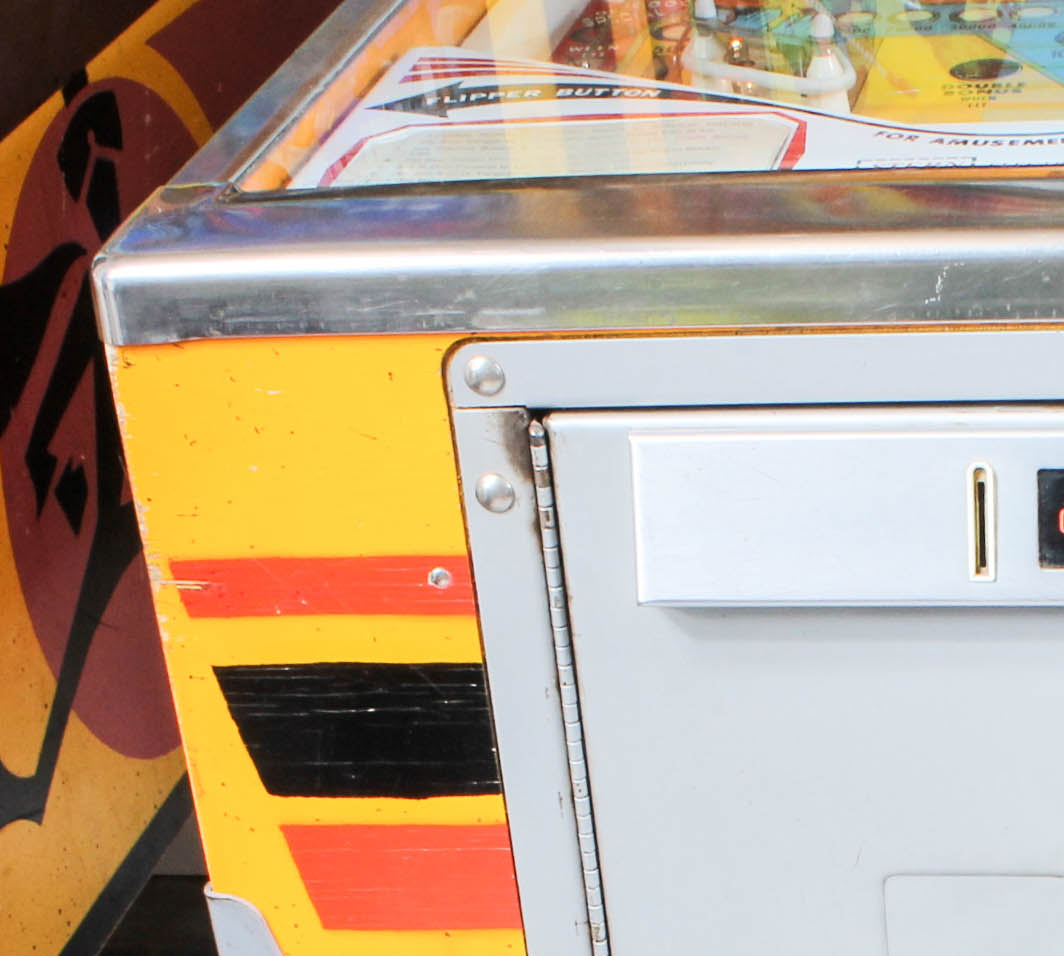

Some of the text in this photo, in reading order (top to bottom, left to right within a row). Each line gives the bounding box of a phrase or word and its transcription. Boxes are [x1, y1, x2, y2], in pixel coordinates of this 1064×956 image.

[425, 87, 663, 106] FLIPPER BUTTON
[874, 130, 920, 143] FOR
